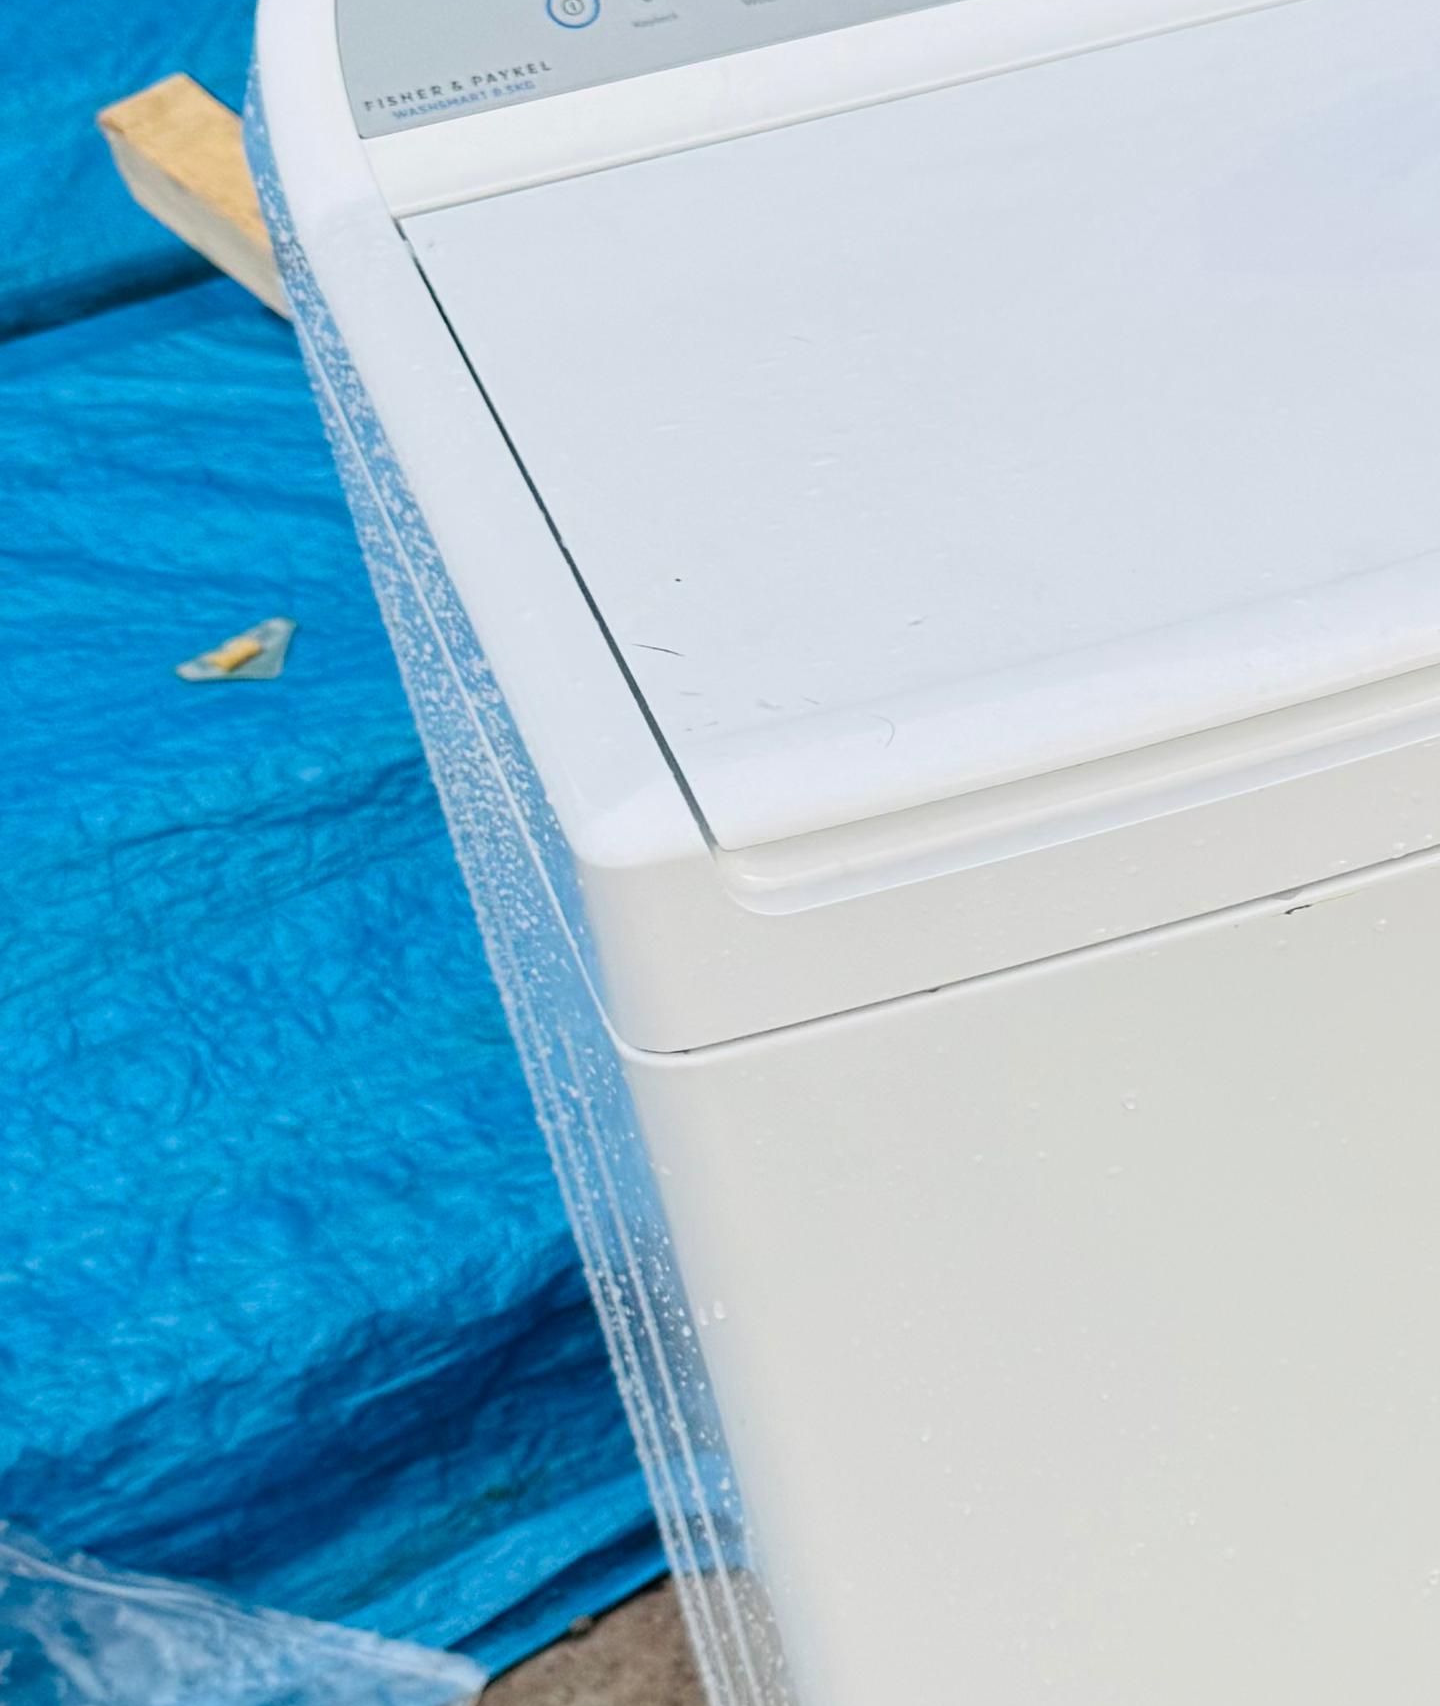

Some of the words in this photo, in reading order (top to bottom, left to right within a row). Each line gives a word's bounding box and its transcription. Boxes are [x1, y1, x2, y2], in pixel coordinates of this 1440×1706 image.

[363, 85, 444, 112] FISHER
[451, 81, 464, 92] &
[471, 60, 552, 87] PAYKEL
[391, 91, 488, 120] WASHSMART
